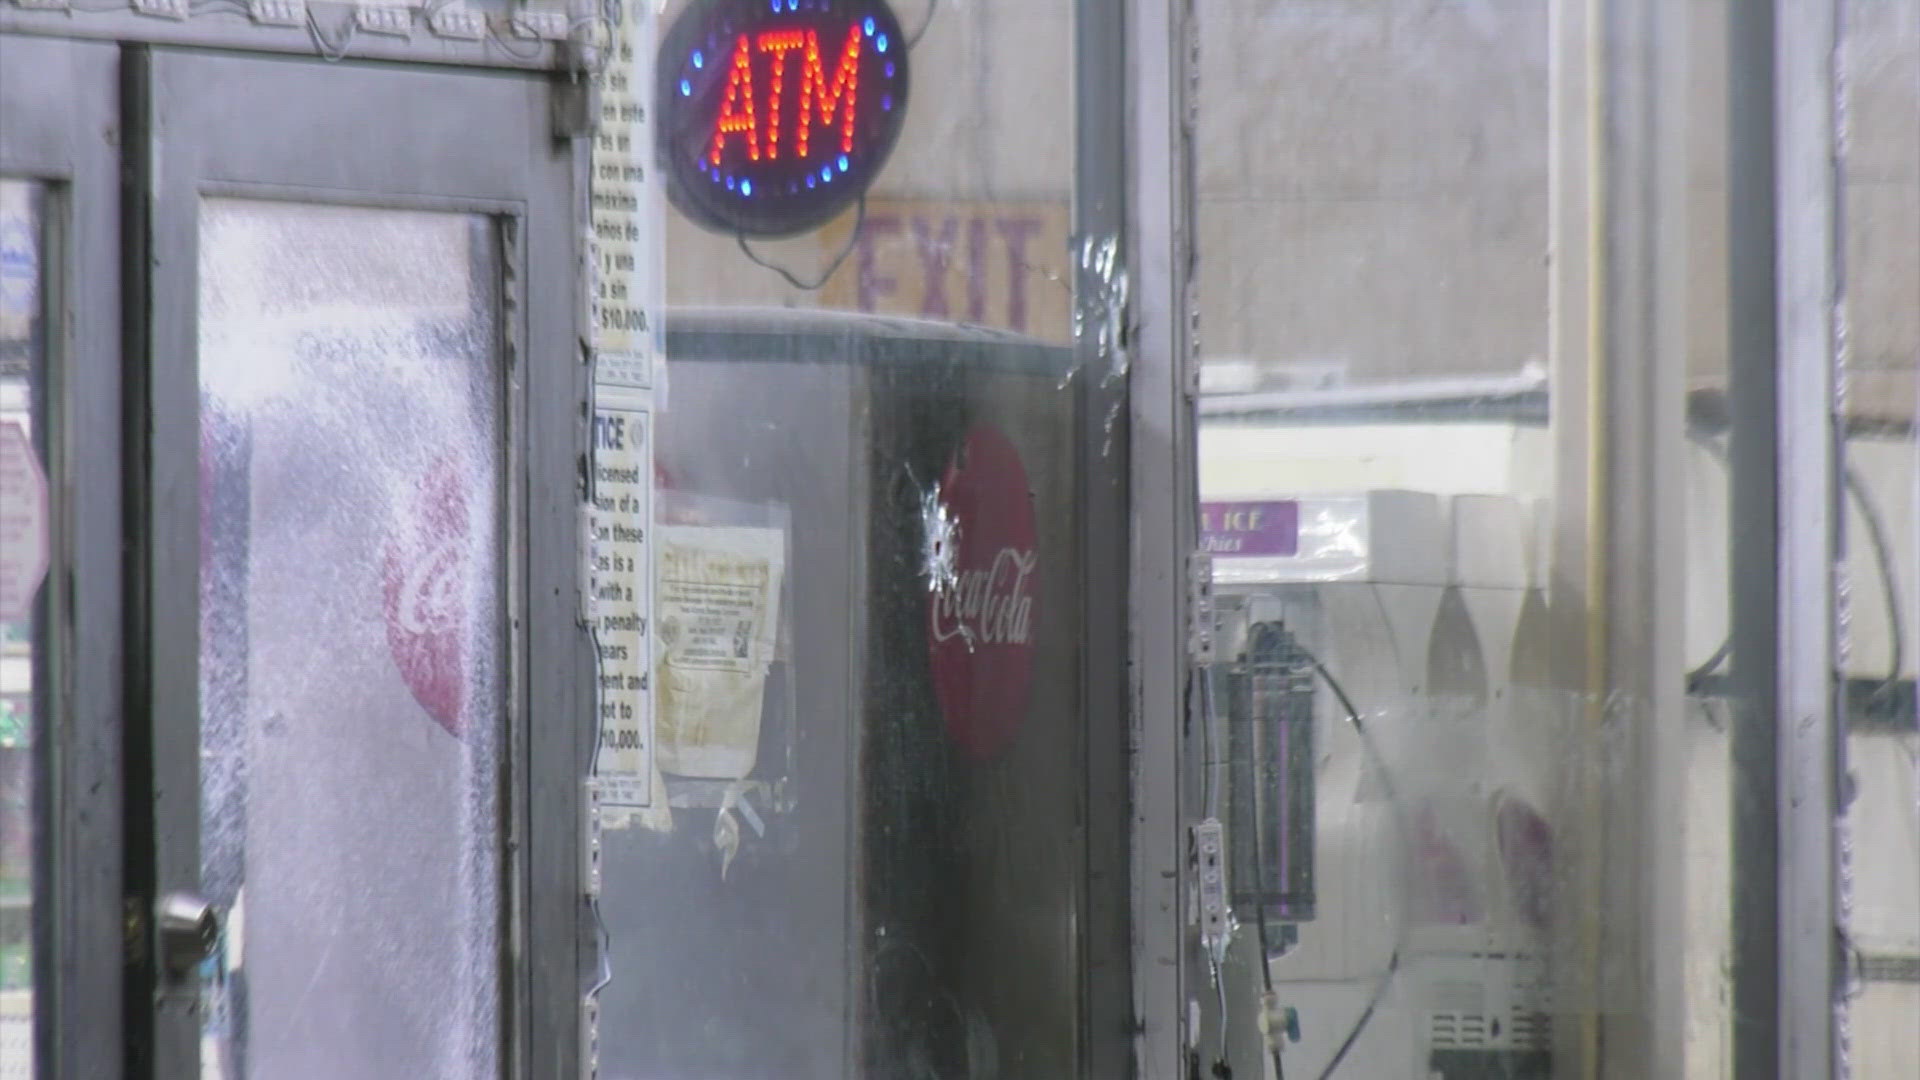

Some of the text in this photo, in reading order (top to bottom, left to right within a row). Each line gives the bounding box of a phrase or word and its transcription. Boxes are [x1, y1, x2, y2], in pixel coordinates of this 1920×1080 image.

[711, 24, 862, 166] ATM
[625, 222, 640, 242] de
[857, 214, 1042, 330] EXIT
[601, 307, 650, 333] $10,000.
[612, 523, 644, 543] these
[603, 613, 646, 637] penalty
[627, 672, 648, 690] and
[619, 702, 632, 719] to
